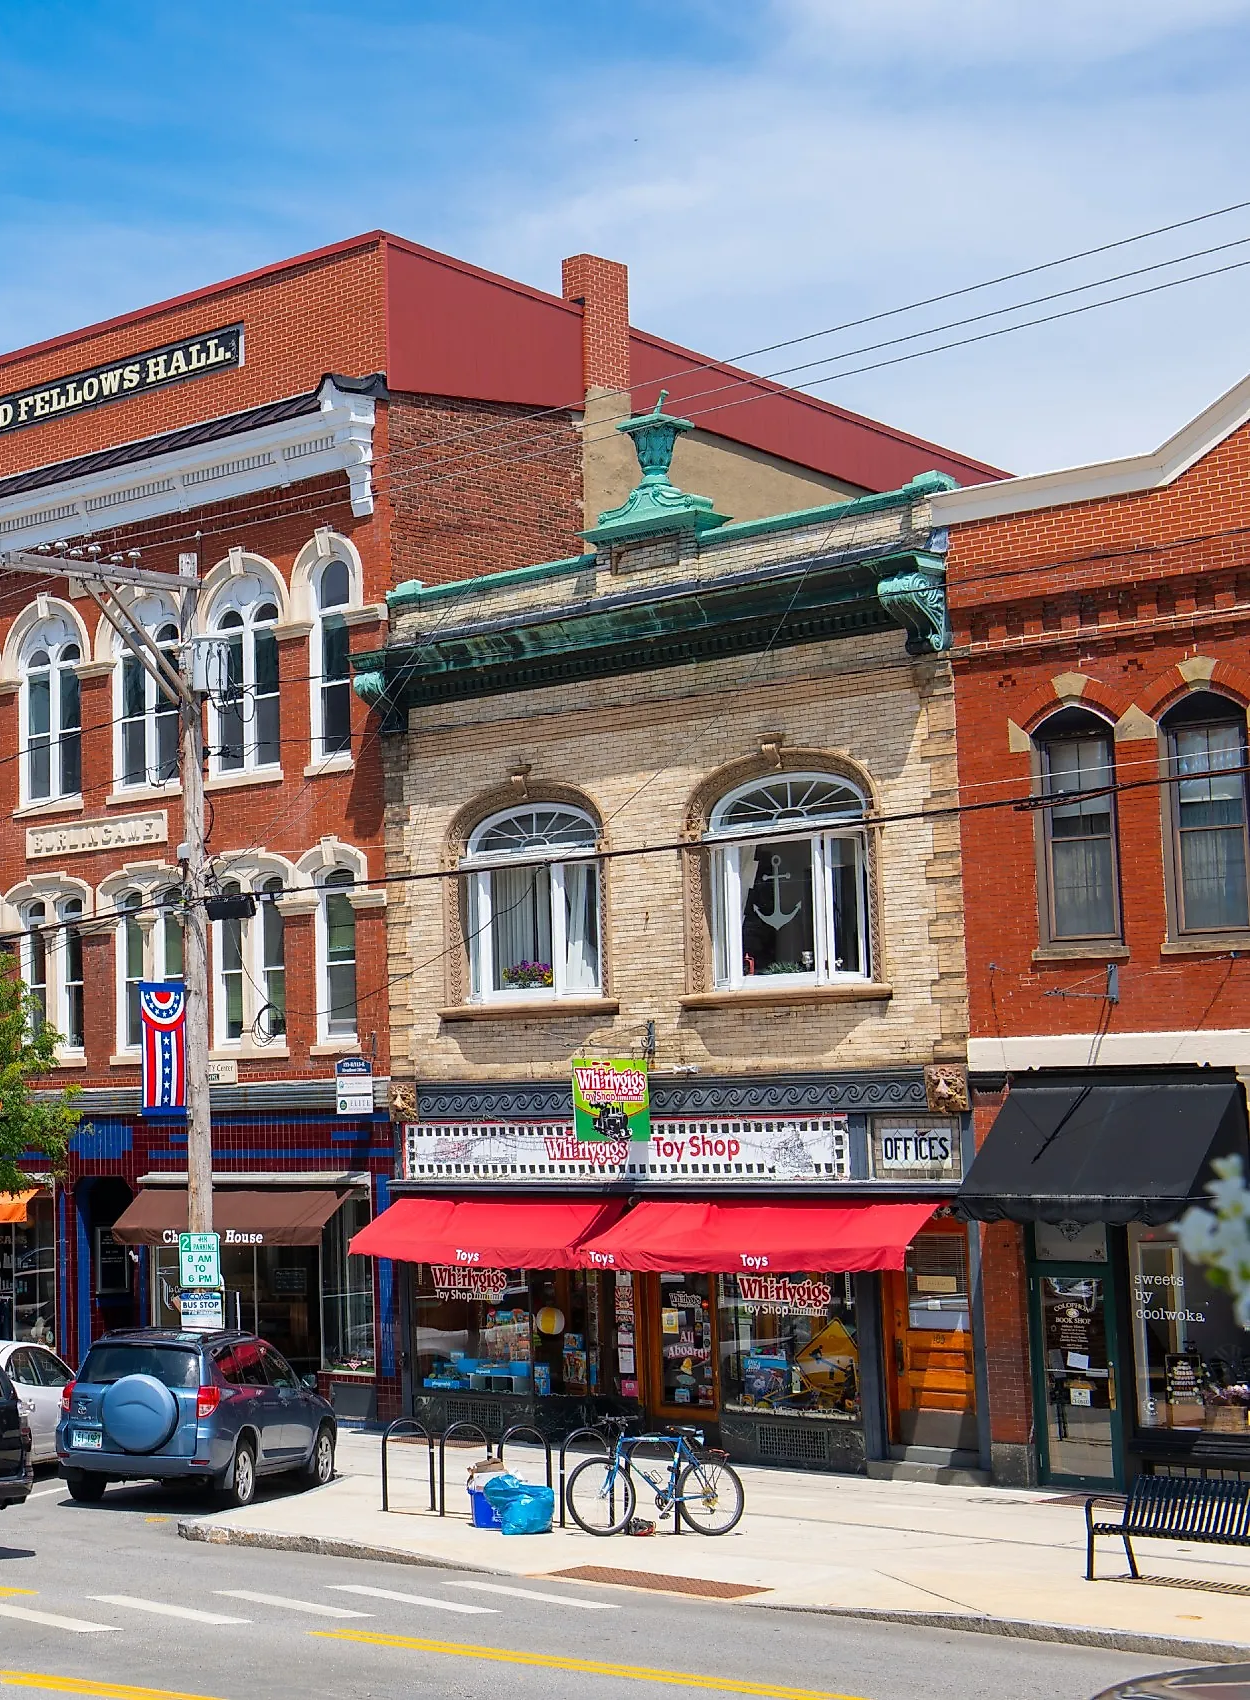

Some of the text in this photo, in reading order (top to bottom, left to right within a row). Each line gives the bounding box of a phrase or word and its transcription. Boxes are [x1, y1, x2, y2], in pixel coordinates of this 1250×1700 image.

[17, 363, 140, 422] FELLOWS
[146, 338, 232, 383] HALL.
[575, 1068, 646, 1096] Whirlygigs
[350, 1099, 371, 1107] ELITE
[581, 1091, 616, 1103] Toy Shop
[544, 1135, 740, 1165] Whirlygigs Toy Shop
[884, 1137, 949, 1160] OFFICES
[181, 1236, 190, 1251] 2
[225, 1229, 264, 1243] House
[193, 1243, 215, 1251] PARKING
[187, 1255, 212, 1263] 8 AM
[456, 1249, 480, 1264] Toys
[589, 1251, 615, 1266] Toys
[740, 1254, 769, 1269] Toys
[431, 1266, 507, 1294] Whirlygigs
[1134, 1273, 1184, 1286] sweets
[435, 1290, 472, 1302] Toy Shop
[738, 1277, 831, 1308] Whirlygigs
[1134, 1288, 1153, 1303] by
[182, 1301, 219, 1309] BUS STOP
[743, 1303, 788, 1318] Toy Shop
[1054, 1302, 1090, 1313] COLOPHON
[1136, 1308, 1206, 1322] coolwoka
[680, 1331, 694, 1343] All
[668, 1345, 708, 1360] Aboard!
